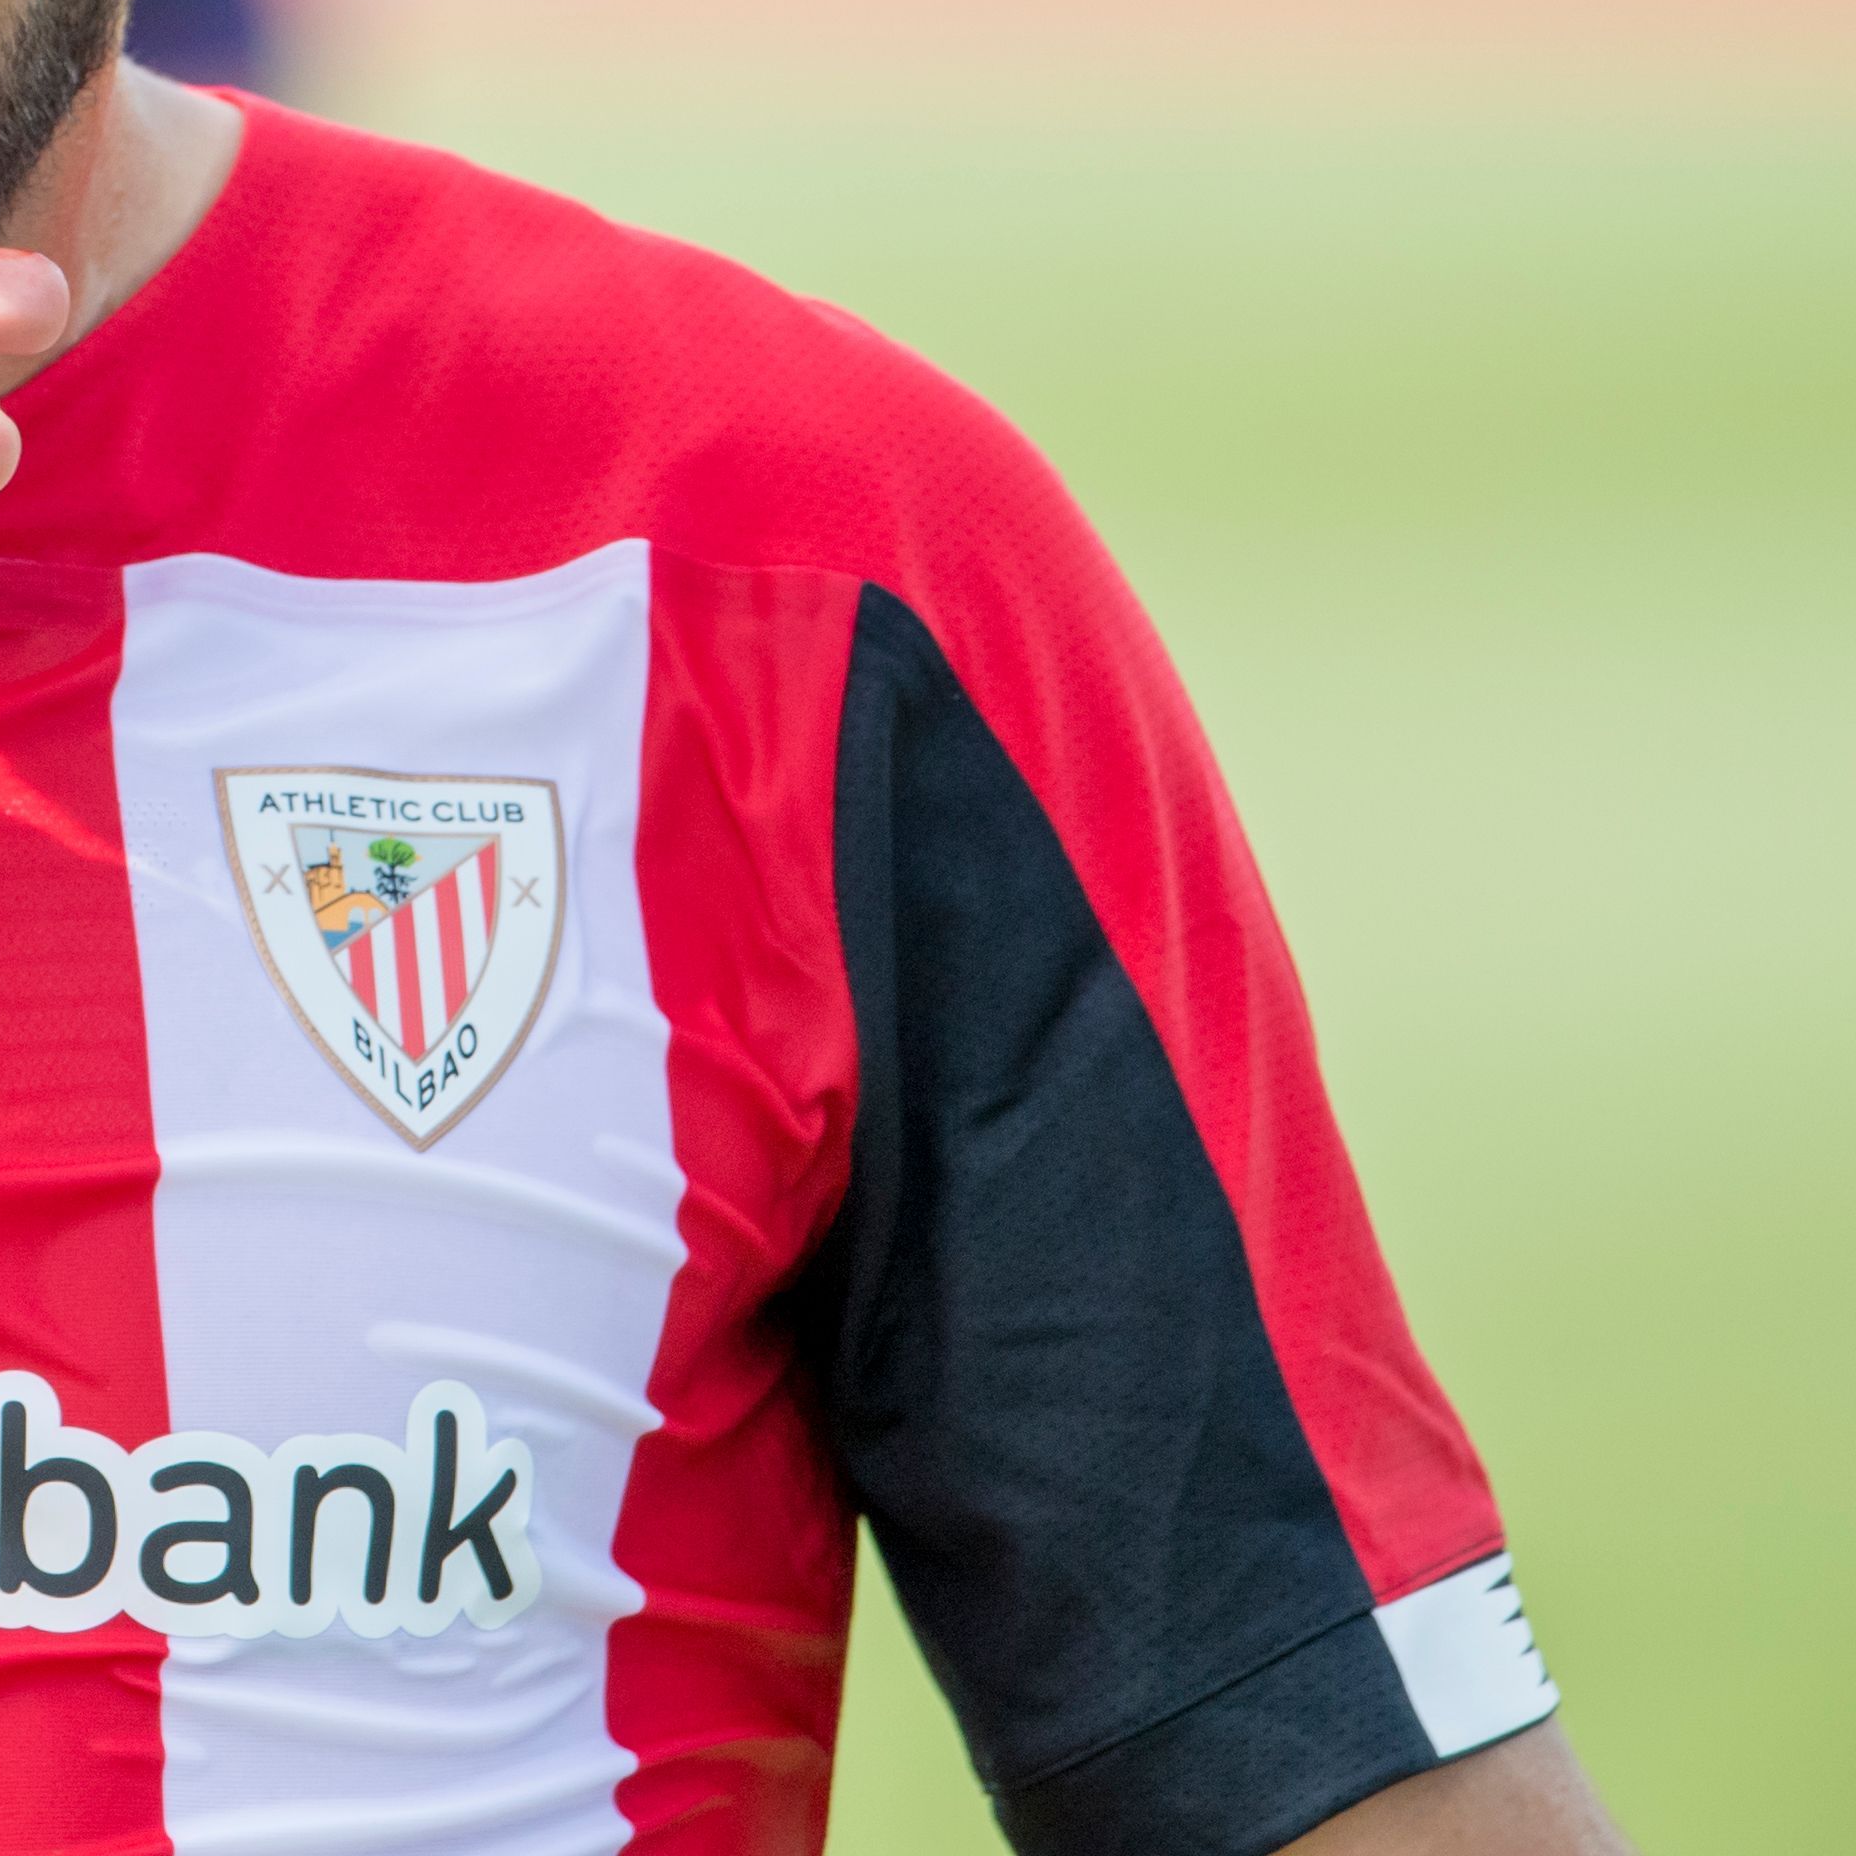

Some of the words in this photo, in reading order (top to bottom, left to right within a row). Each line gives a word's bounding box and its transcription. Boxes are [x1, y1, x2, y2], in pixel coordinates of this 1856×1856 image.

[257, 791, 423, 823] ATHLETIC
[431, 800, 525, 824] CLUB
[351, 1017, 479, 1113] BILBAO
